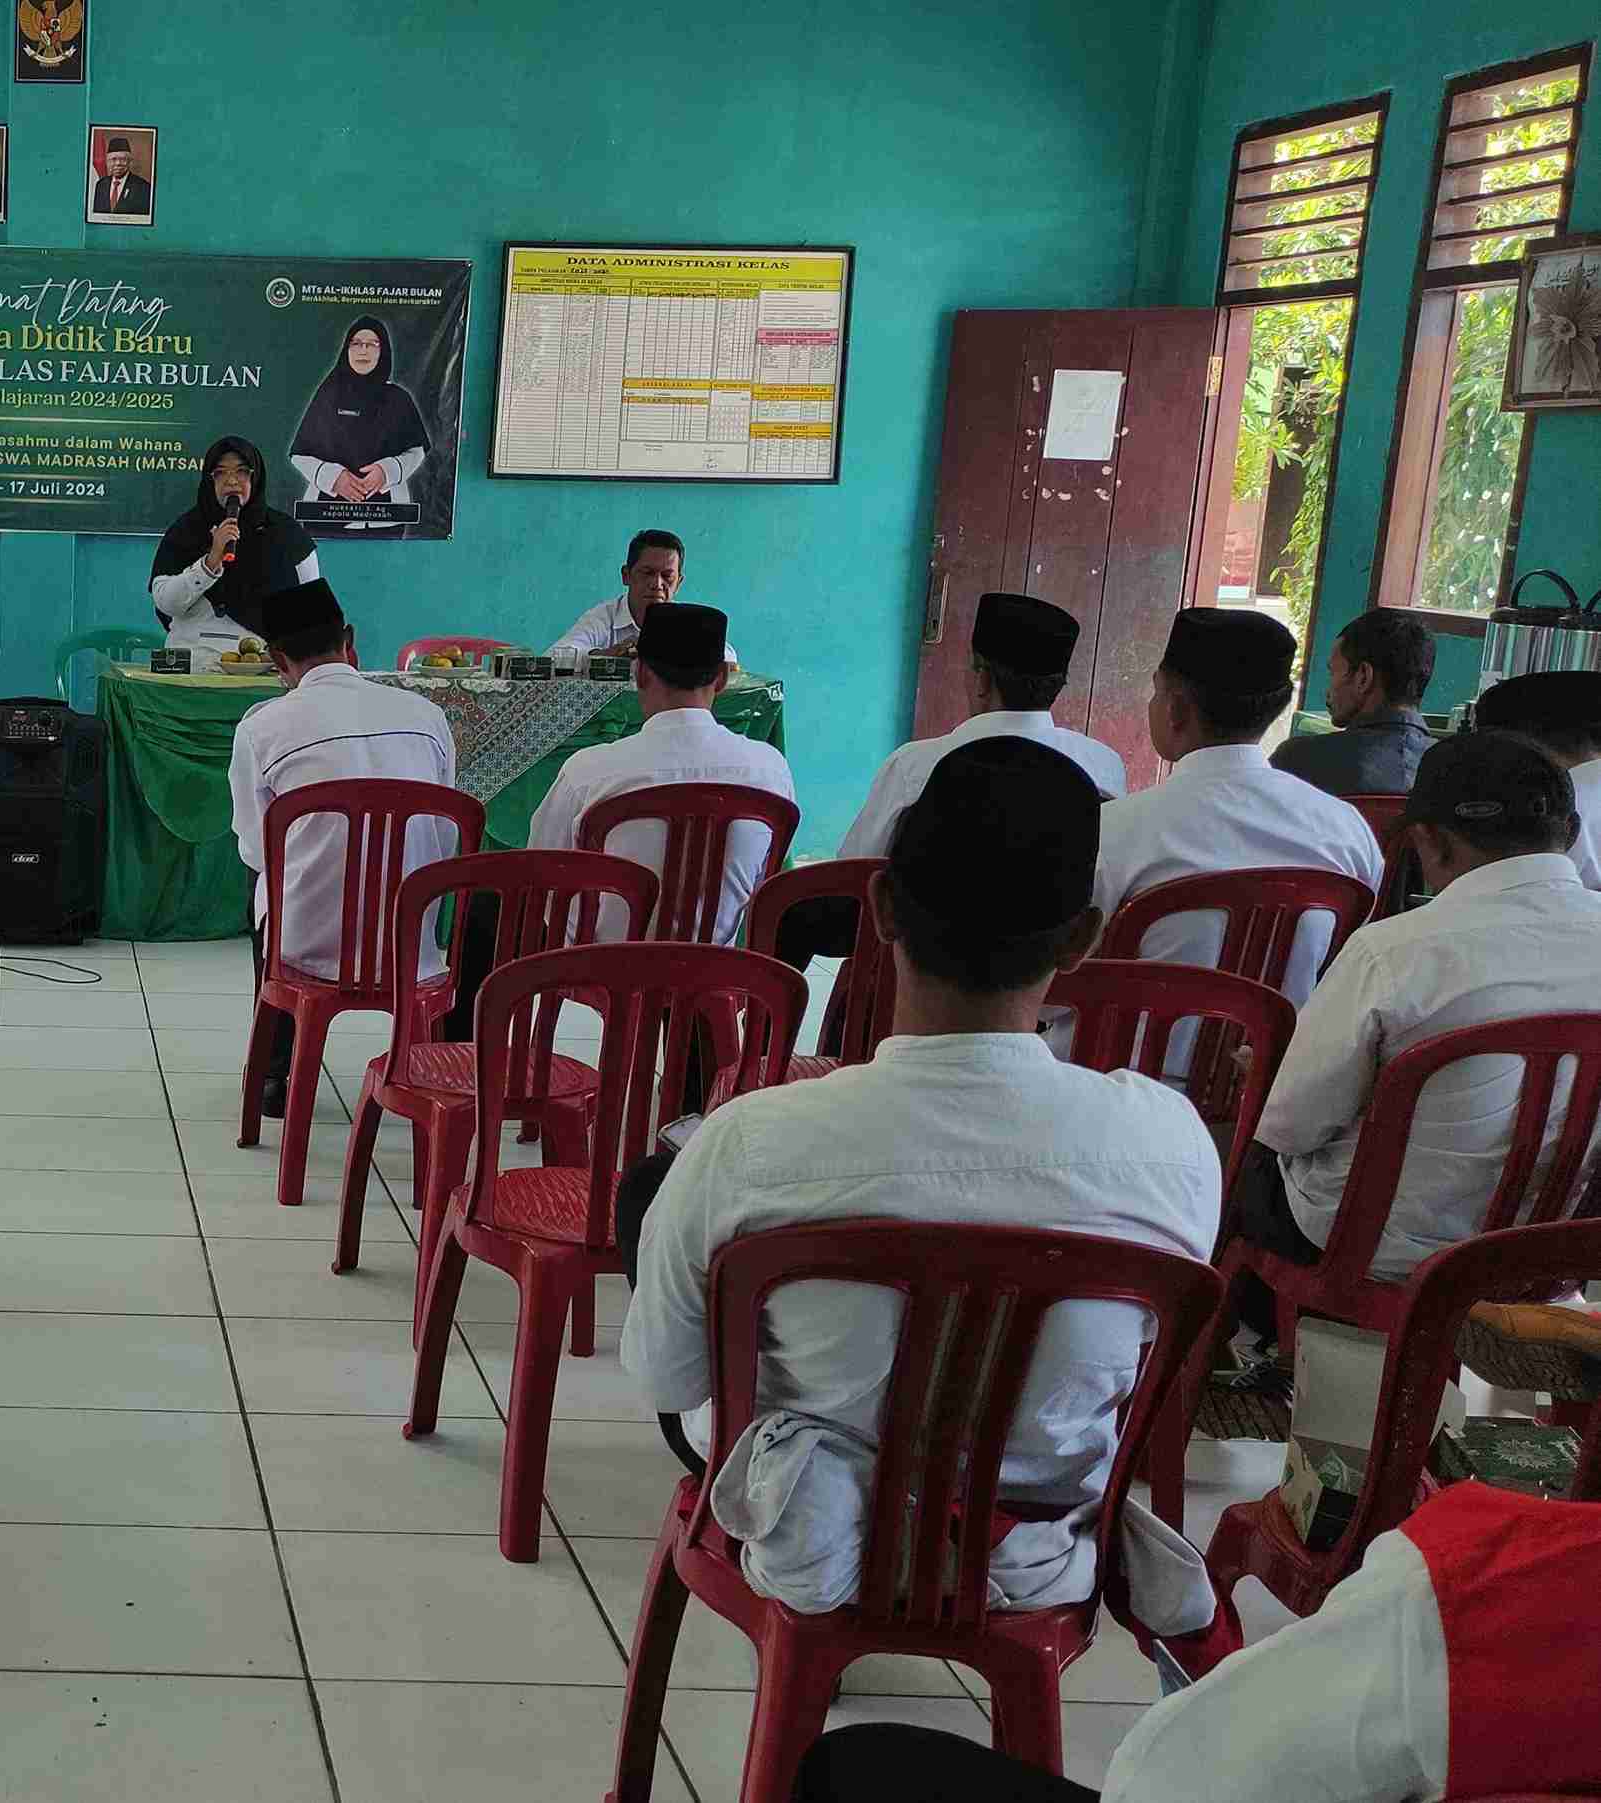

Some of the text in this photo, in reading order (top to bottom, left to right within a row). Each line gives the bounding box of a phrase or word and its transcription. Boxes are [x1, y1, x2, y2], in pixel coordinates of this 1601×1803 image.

[567, 256, 791, 271] DATA ADMINISTRASI KELAS
[324, 286, 375, 295] AL-IKHLAS
[377, 287, 408, 296] FAJAR
[410, 287, 442, 297] BULAN
[58, 278, 173, 341] Datang
[20, 324, 106, 351] Didik
[114, 327, 193, 354] Baru
[60, 359, 153, 385] FAJAR
[160, 363, 262, 387] BULAN
[69, 391, 174, 408] 2024/2025
[65, 435, 113, 449] dalam
[119, 438, 183, 451] Wahana
[37, 454, 130, 468] MADRASAH
[9, 480, 26, 494] 17
[30, 482, 60, 495] Juli
[65, 483, 105, 496] 2024
